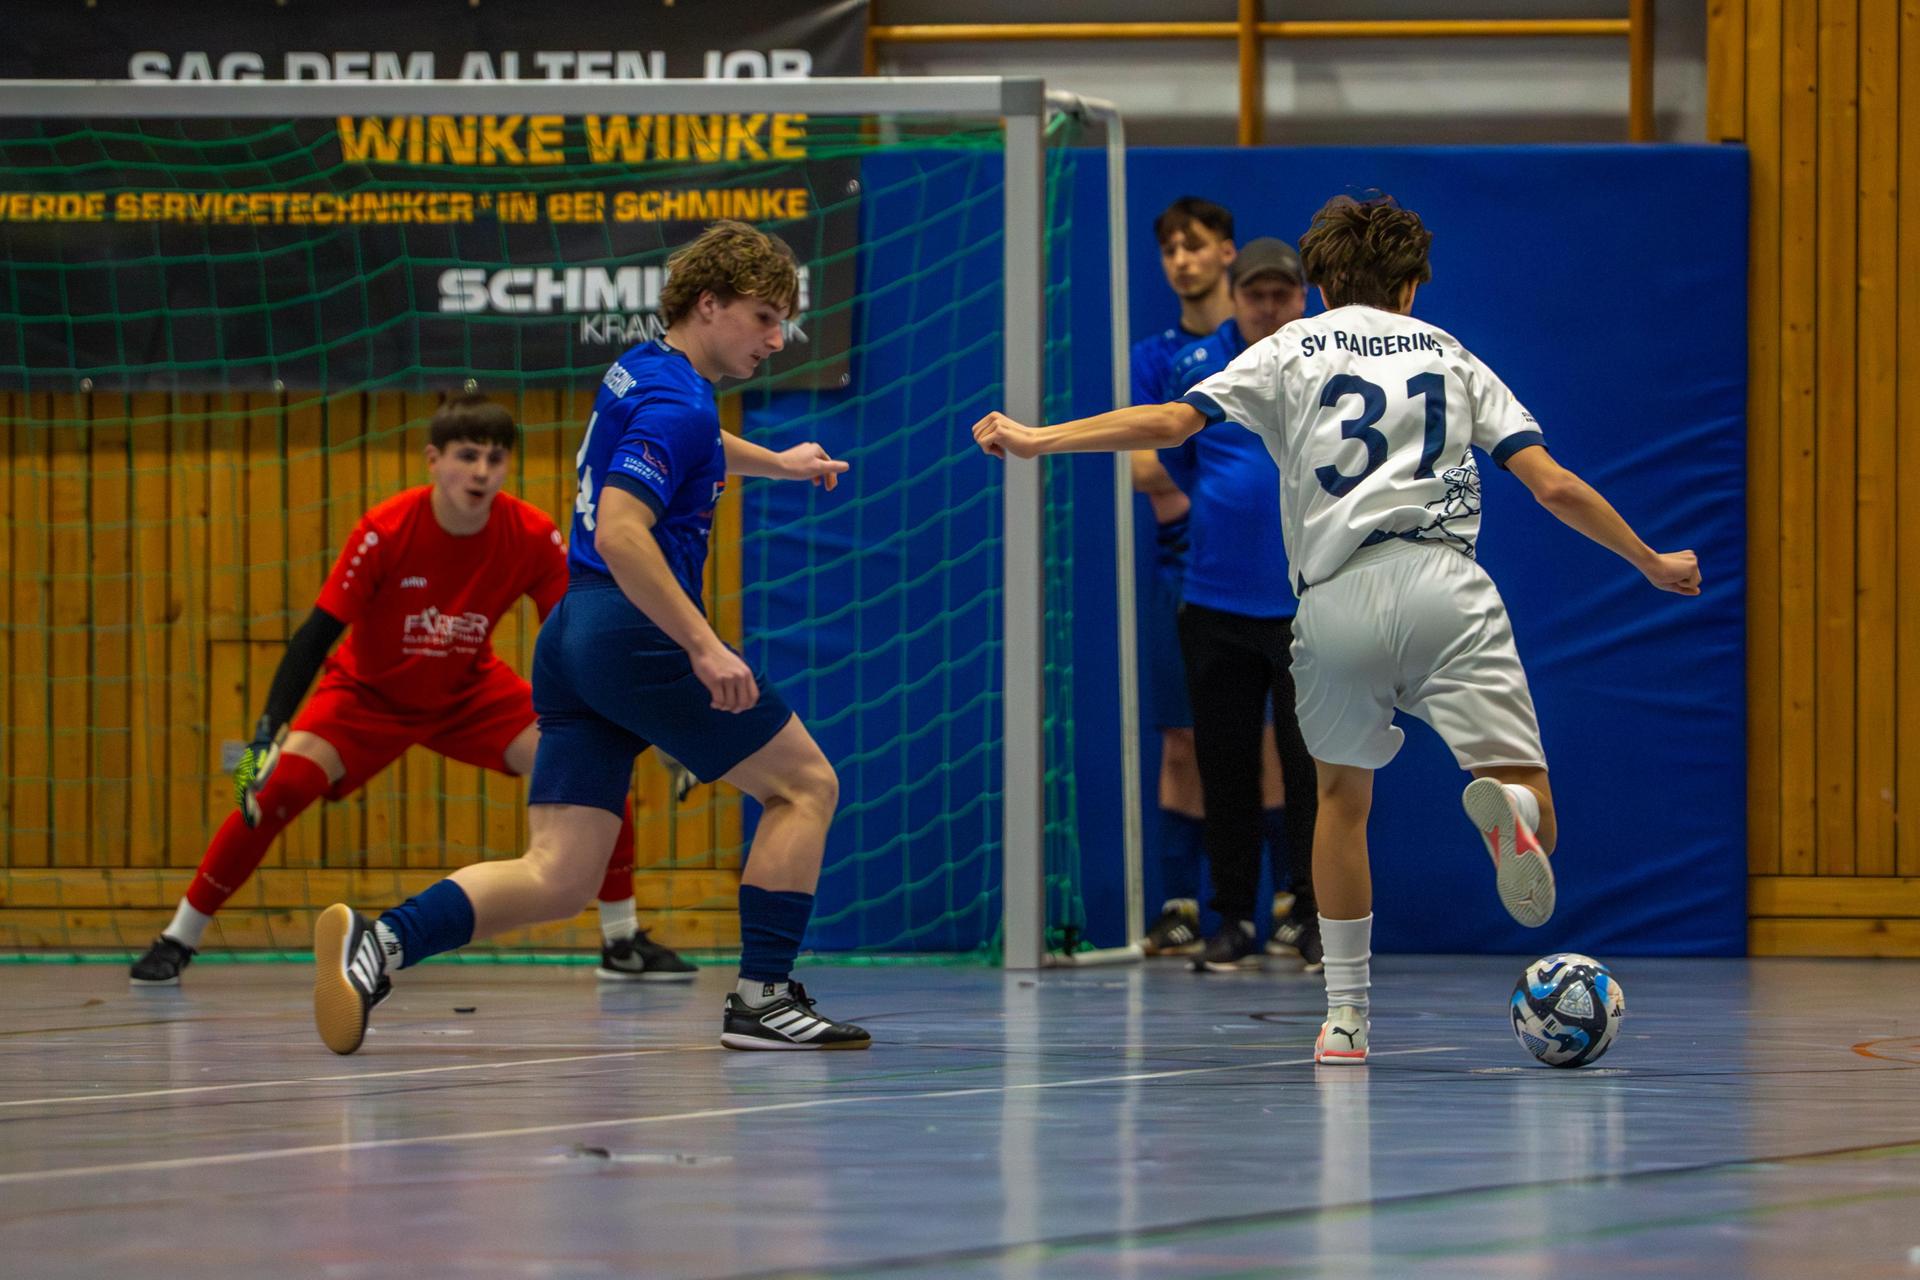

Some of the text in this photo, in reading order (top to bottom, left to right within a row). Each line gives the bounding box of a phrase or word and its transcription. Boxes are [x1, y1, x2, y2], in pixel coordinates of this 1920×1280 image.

[128, 51, 266, 80] SAG
[284, 51, 436, 80] DEM
[337, 113, 809, 164] WINKE WINKE
[546, 191, 605, 223] BEI
[614, 188, 809, 222] SCHMINKE
[1301, 330, 1444, 358] SV RAIGERING
[1315, 372, 1446, 499] 31
